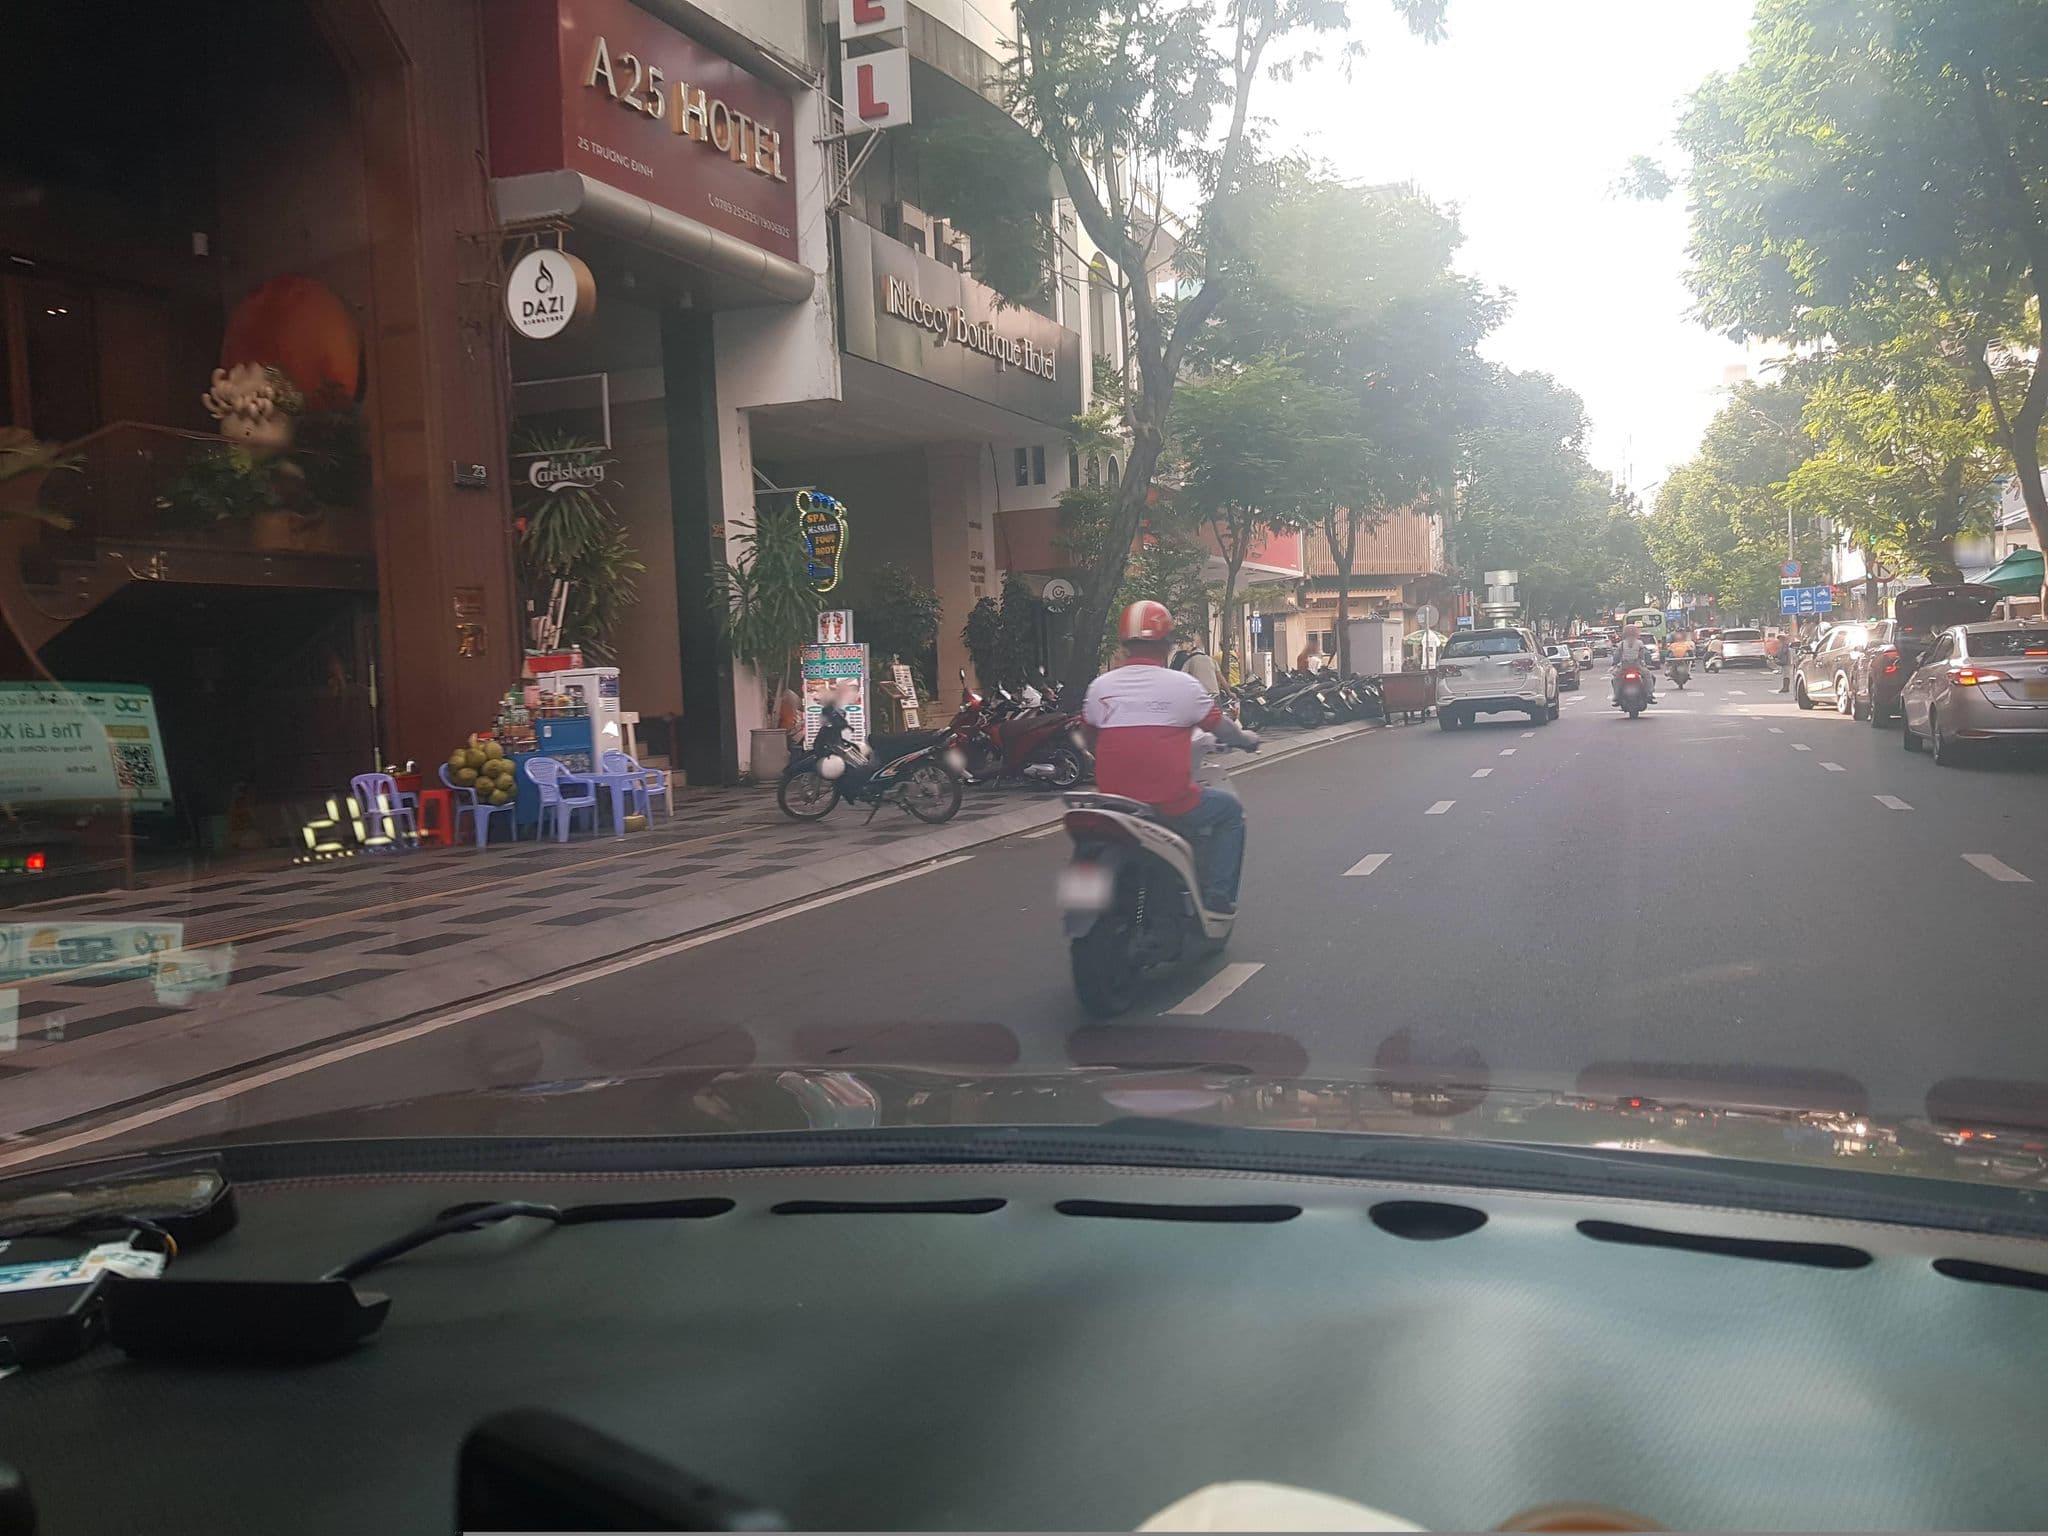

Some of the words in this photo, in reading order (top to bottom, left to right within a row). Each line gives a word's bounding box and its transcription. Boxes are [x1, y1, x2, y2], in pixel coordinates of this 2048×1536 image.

[584, 36, 667, 121] A25
[673, 80, 788, 183] HOTEL
[577, 135, 590, 151] 25
[522, 295, 564, 318] DAZI
[884, 274, 952, 348] Nicecy
[950, 305, 1022, 373] Boutique
[1022, 338, 1057, 382] Hotel
[529, 460, 605, 490] Carlsberg
[806, 513, 826, 524] SPA
[815, 546, 836, 556] BODY
